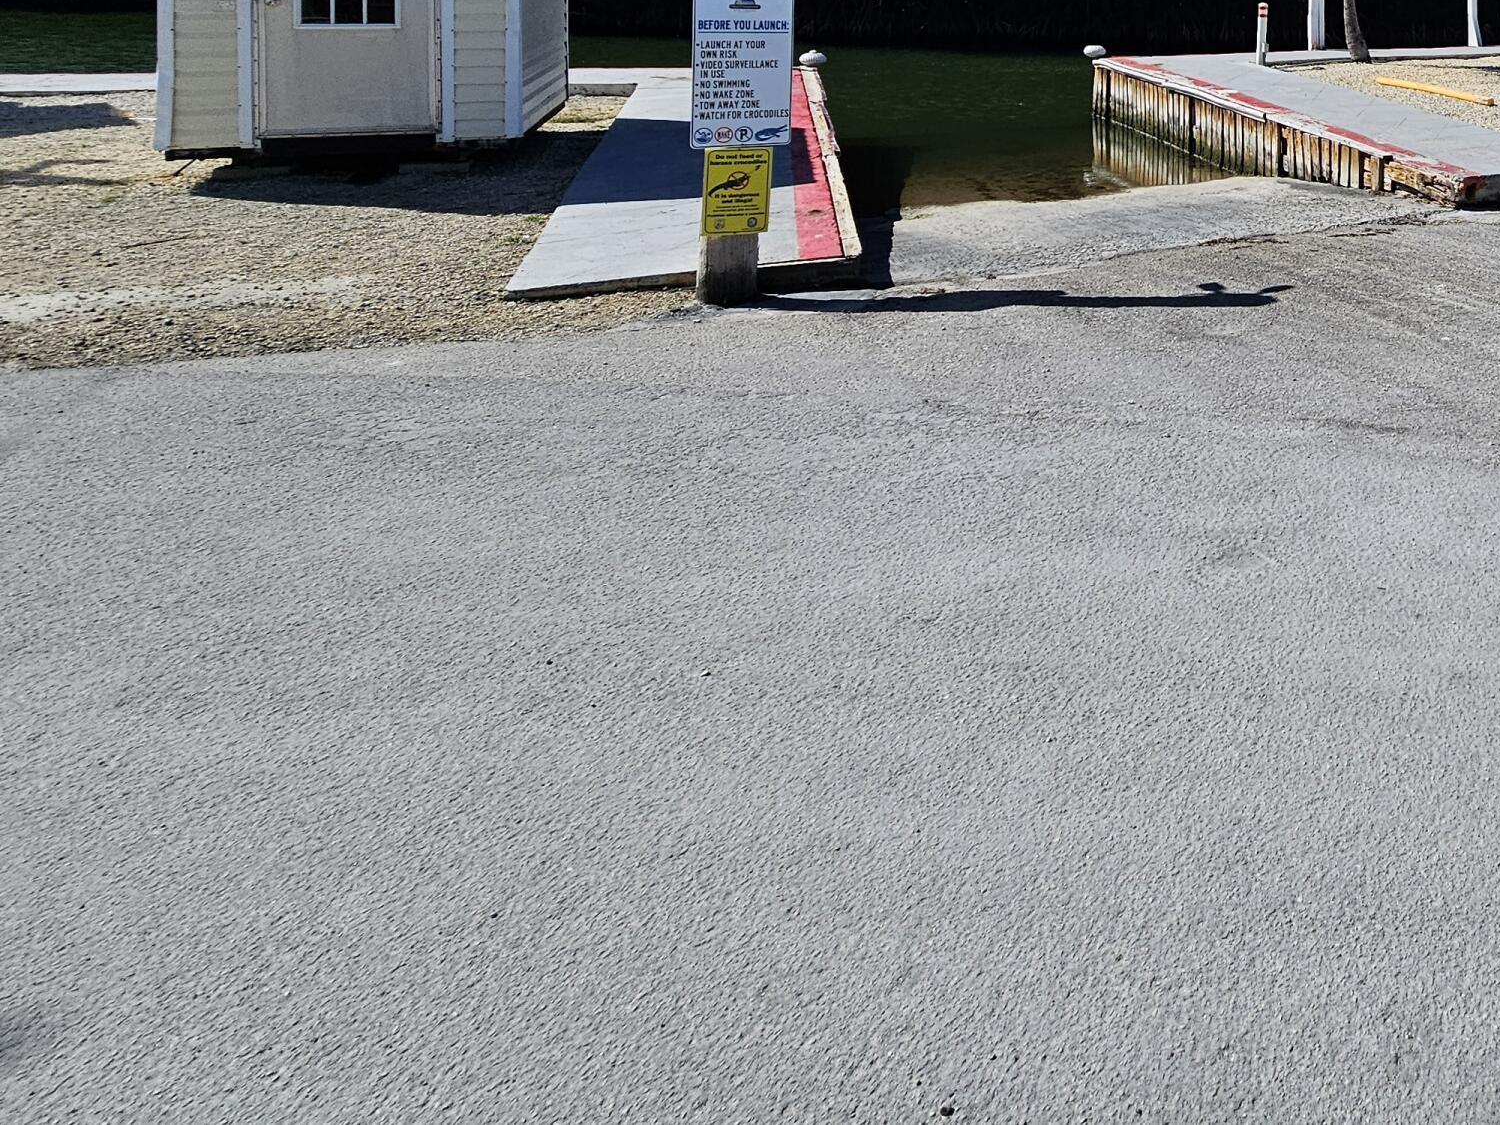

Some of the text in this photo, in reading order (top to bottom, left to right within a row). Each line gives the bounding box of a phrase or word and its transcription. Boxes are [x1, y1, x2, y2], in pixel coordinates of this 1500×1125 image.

[698, 20, 790, 30] BEFORE YOU LAUNCH:
[700, 40, 766, 49] LAUNCH AT YOUR
[700, 50, 737, 59] OWN RISK
[700, 60, 779, 69] VIDEO SURVEILLANCE
[701, 70, 725, 78] IN USE
[700, 79, 750, 89] NO SWIMMING
[700, 89, 755, 99] NO WAKE ZONE
[699, 99, 760, 110] TOW AWAY ZONE
[699, 109, 789, 120] WATCH FOR CROCODILES
